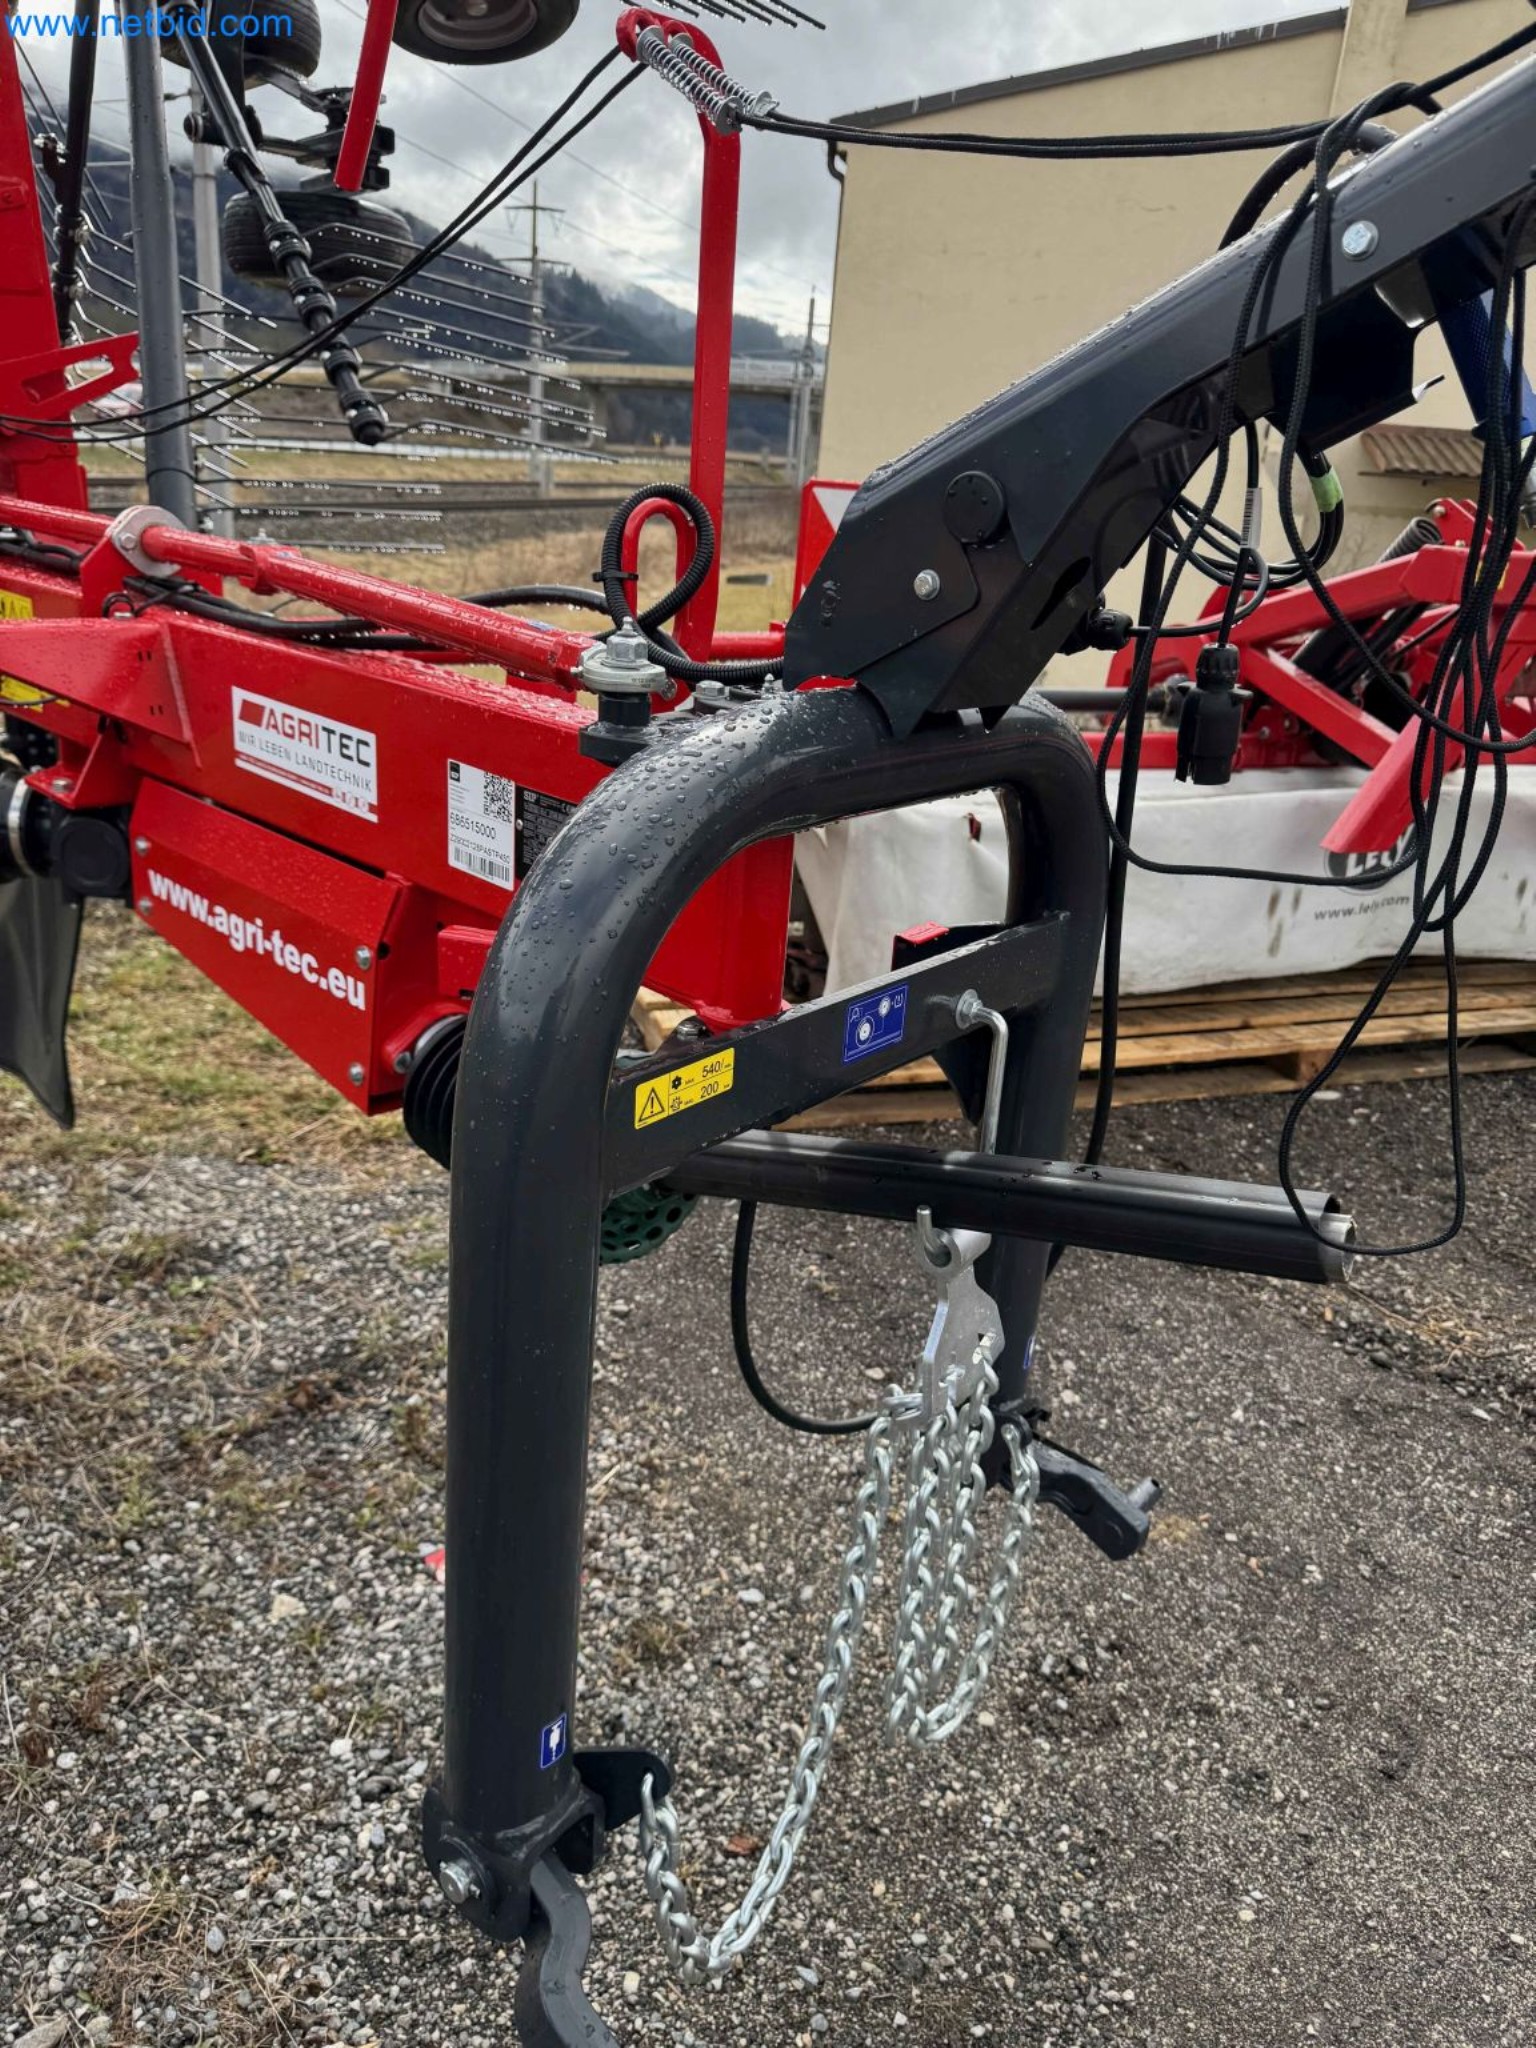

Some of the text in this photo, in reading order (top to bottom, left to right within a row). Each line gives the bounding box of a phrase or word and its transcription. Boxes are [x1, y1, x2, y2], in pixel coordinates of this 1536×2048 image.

[238, 729, 255, 746] WIR
[258, 738, 291, 761] LEBEN
[295, 752, 372, 793] LANDTECHNIK
[265, 707, 371, 768] AGRITEC
[148, 869, 366, 1011] www.agri-tec.eu
[701, 1081, 719, 1099] 200
